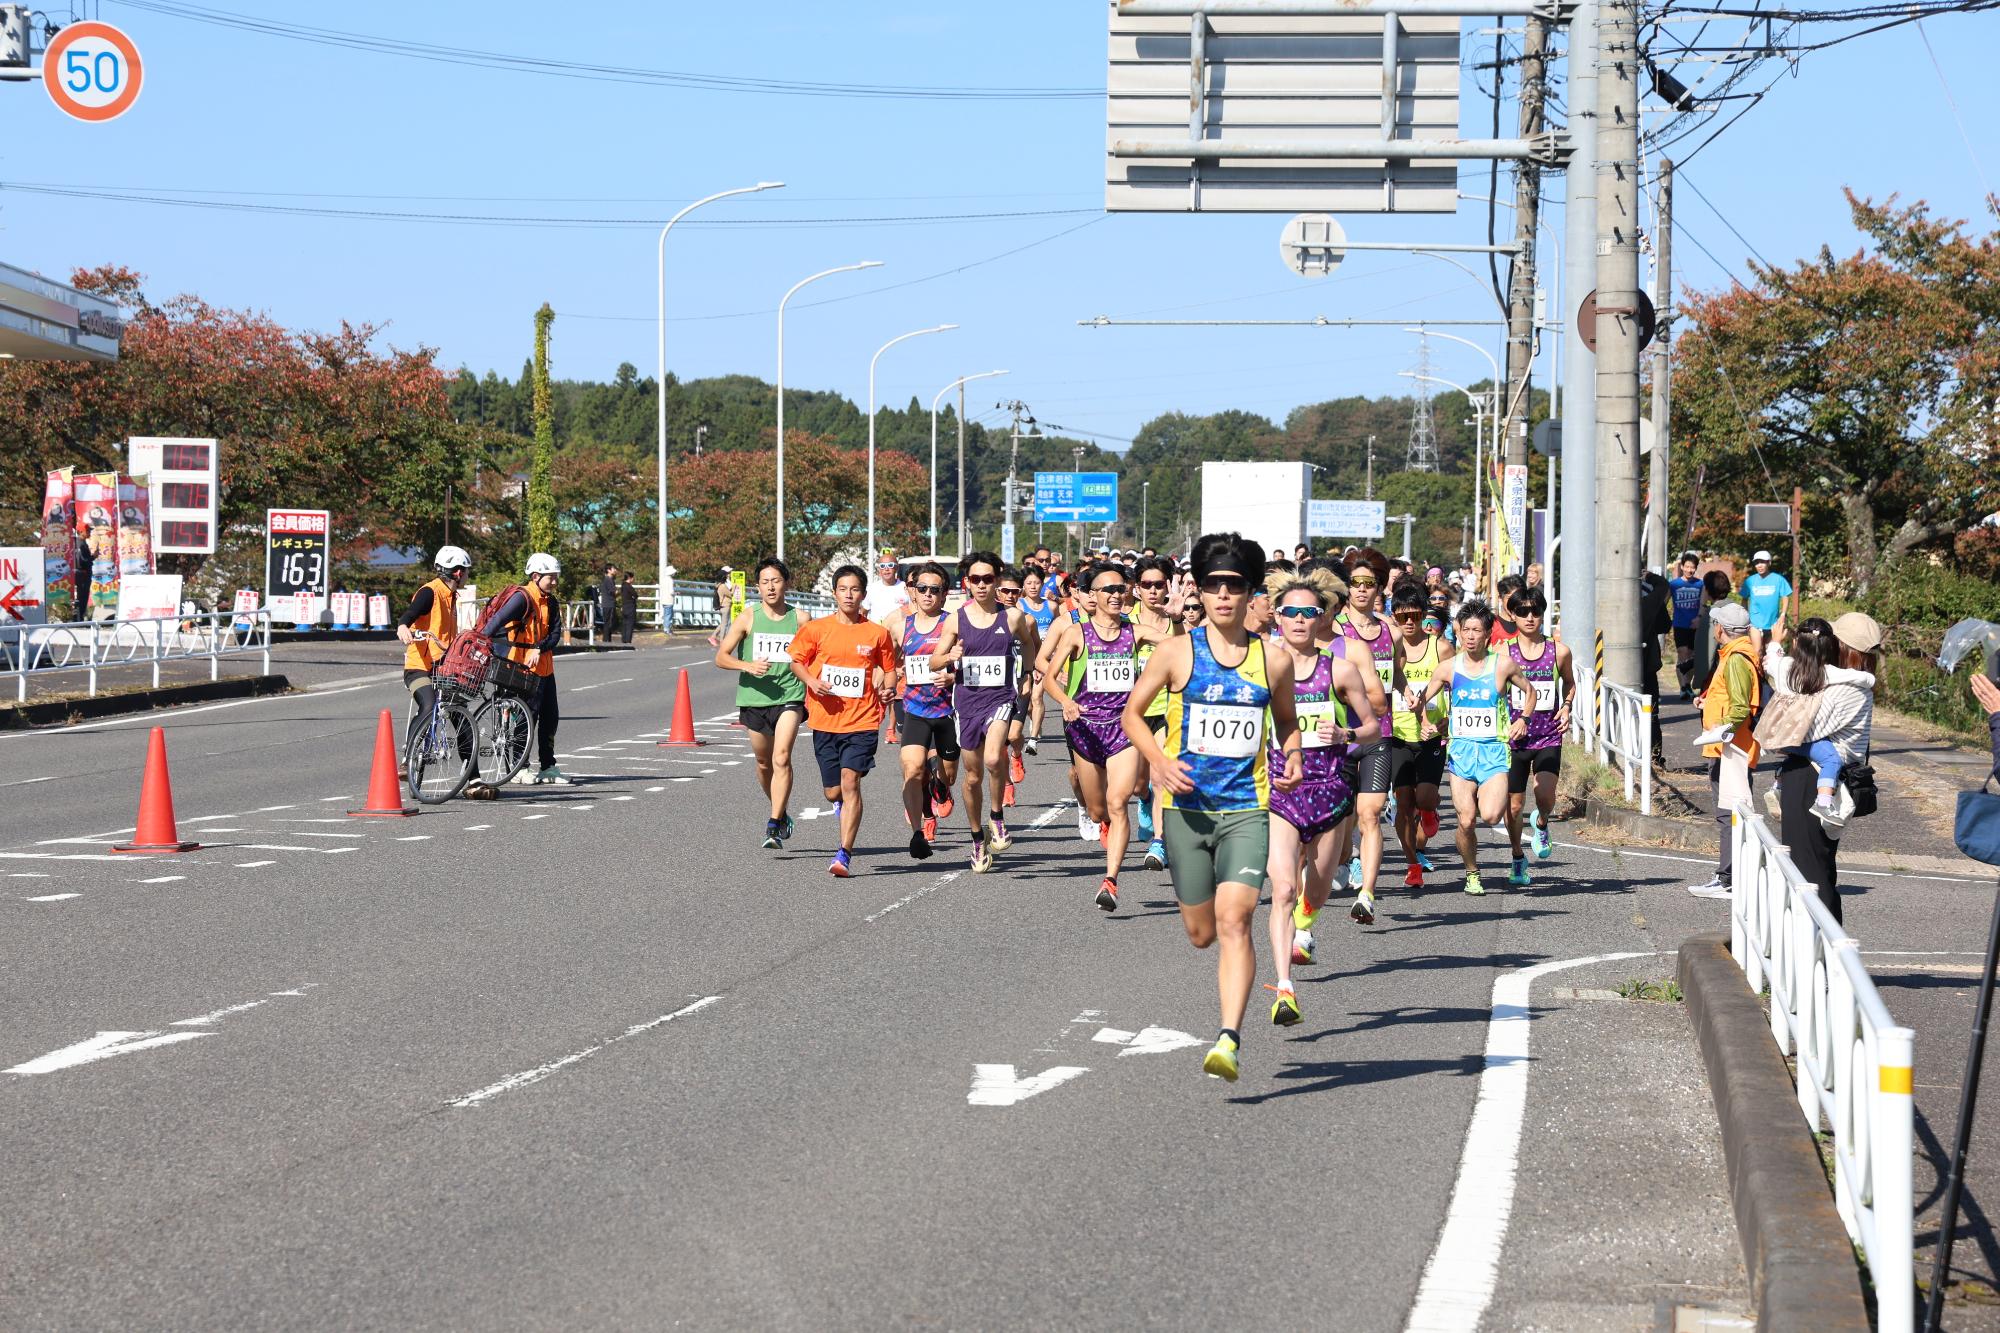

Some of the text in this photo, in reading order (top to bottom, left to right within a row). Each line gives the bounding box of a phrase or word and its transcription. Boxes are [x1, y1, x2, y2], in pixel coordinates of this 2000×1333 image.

[67, 51, 119, 92] 50
[271, 515, 325, 531] 会員価格
[271, 538, 324, 549] レギュラー
[281, 553, 323, 586] 163
[910, 663, 929, 675] 11
[967, 664, 1001, 677] 1146
[1093, 667, 1130, 680] 1109
[1405, 669, 1433, 678] まかわ
[826, 674, 860, 687] 1088
[1203, 684, 1255, 703] 伊達
[1456, 688, 1491, 700] やぶき
[1517, 689, 1550, 701] 107
[1457, 715, 1492, 728] 1079
[1199, 718, 1256, 740] 1070
